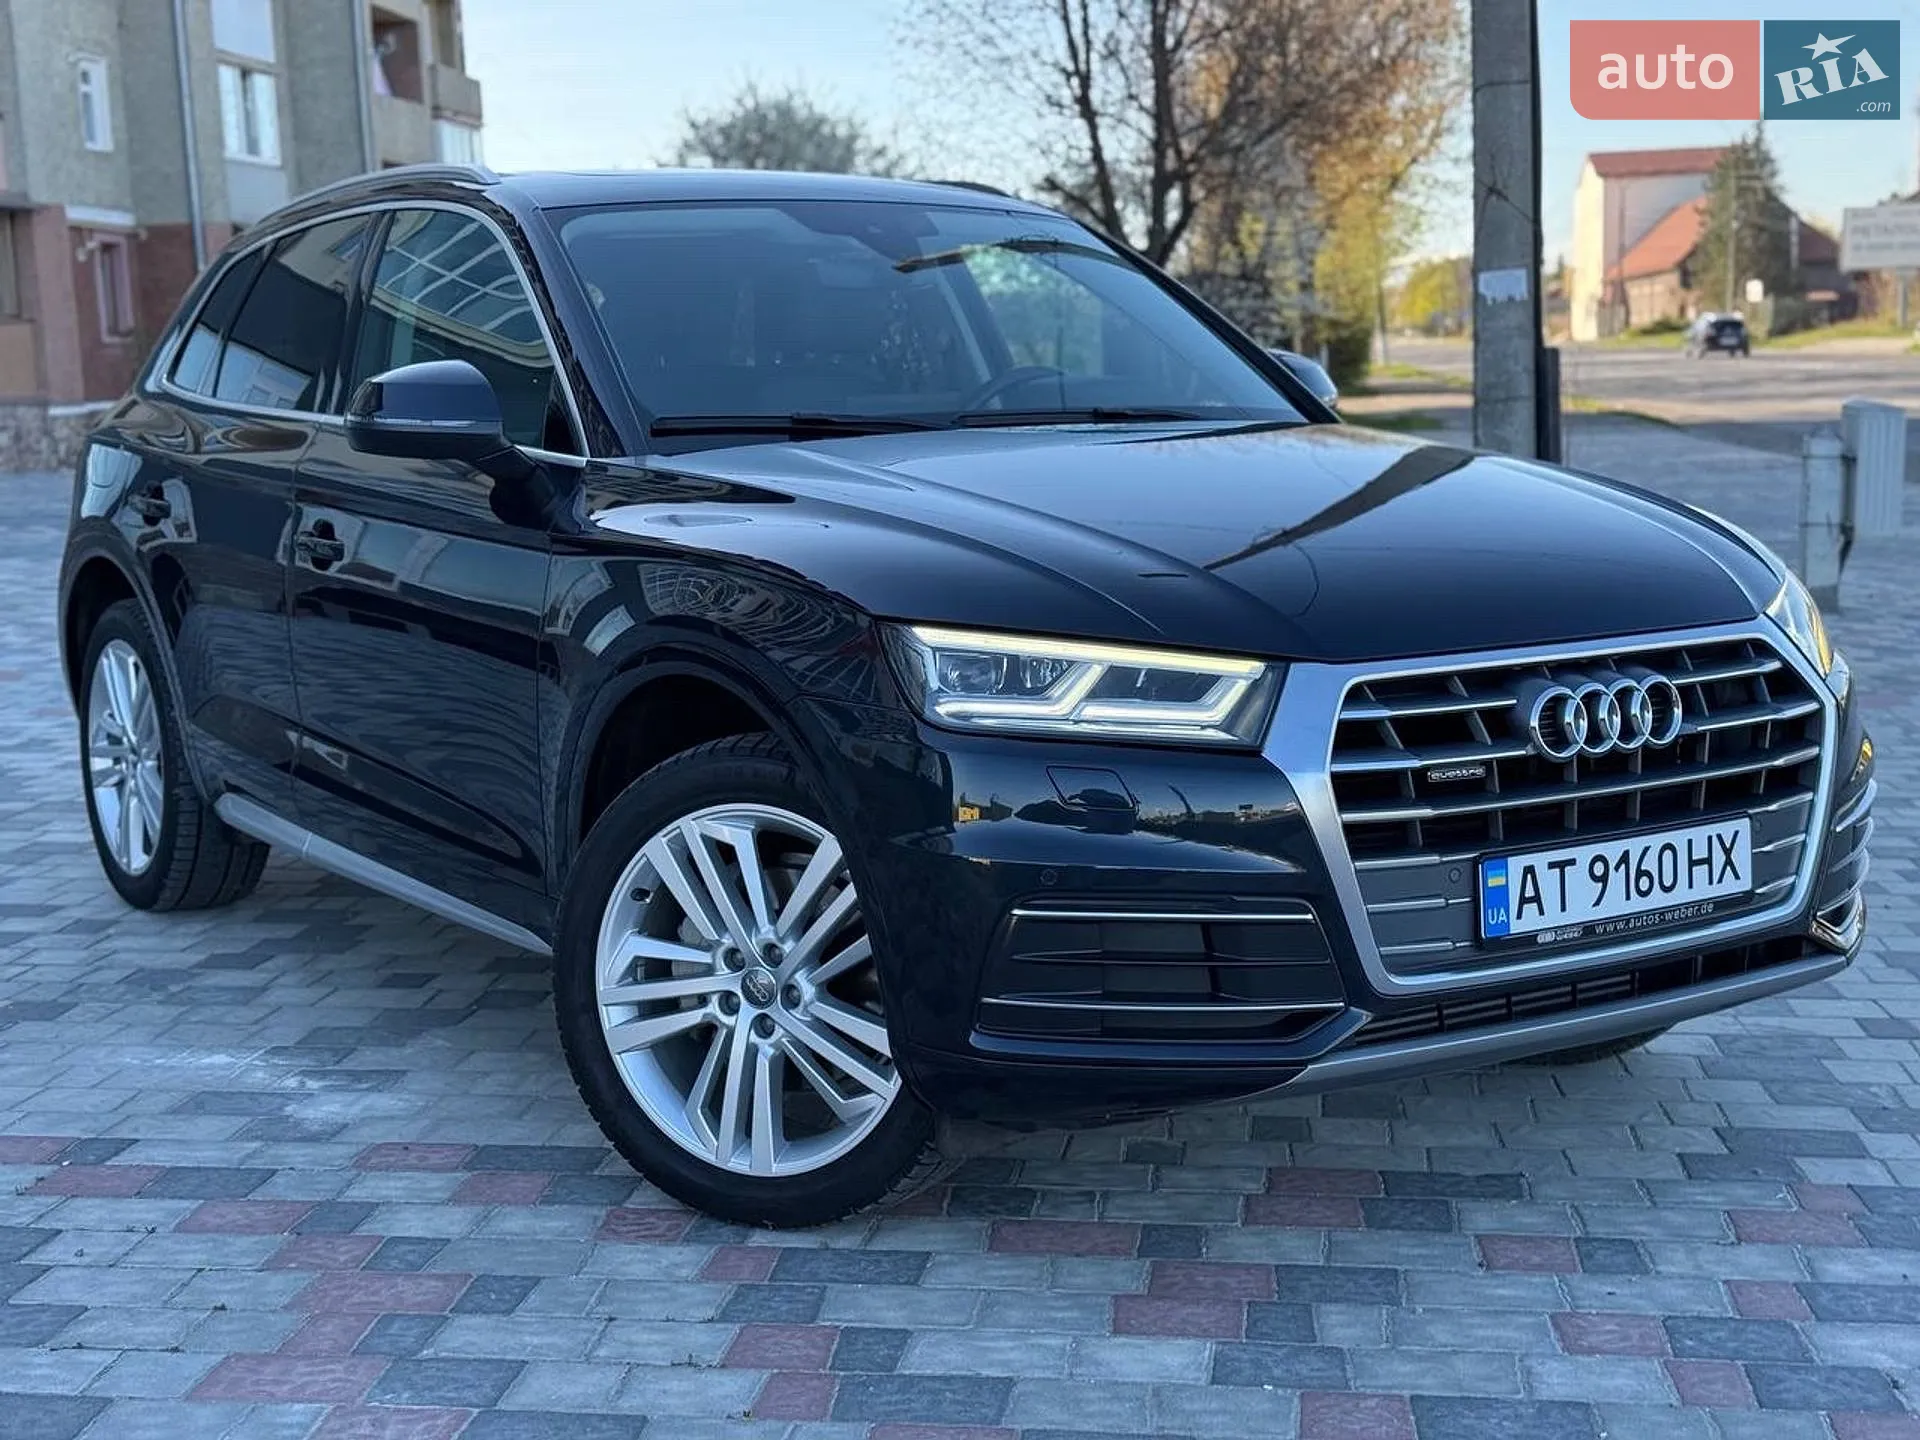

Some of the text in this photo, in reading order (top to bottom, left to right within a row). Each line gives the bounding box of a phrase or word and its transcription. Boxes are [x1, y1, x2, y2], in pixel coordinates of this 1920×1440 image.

[1516, 829, 1742, 921] AT 9160 HX
[1488, 907, 1508, 925] UA
[1594, 902, 1714, 935] www.autos-weber.de
